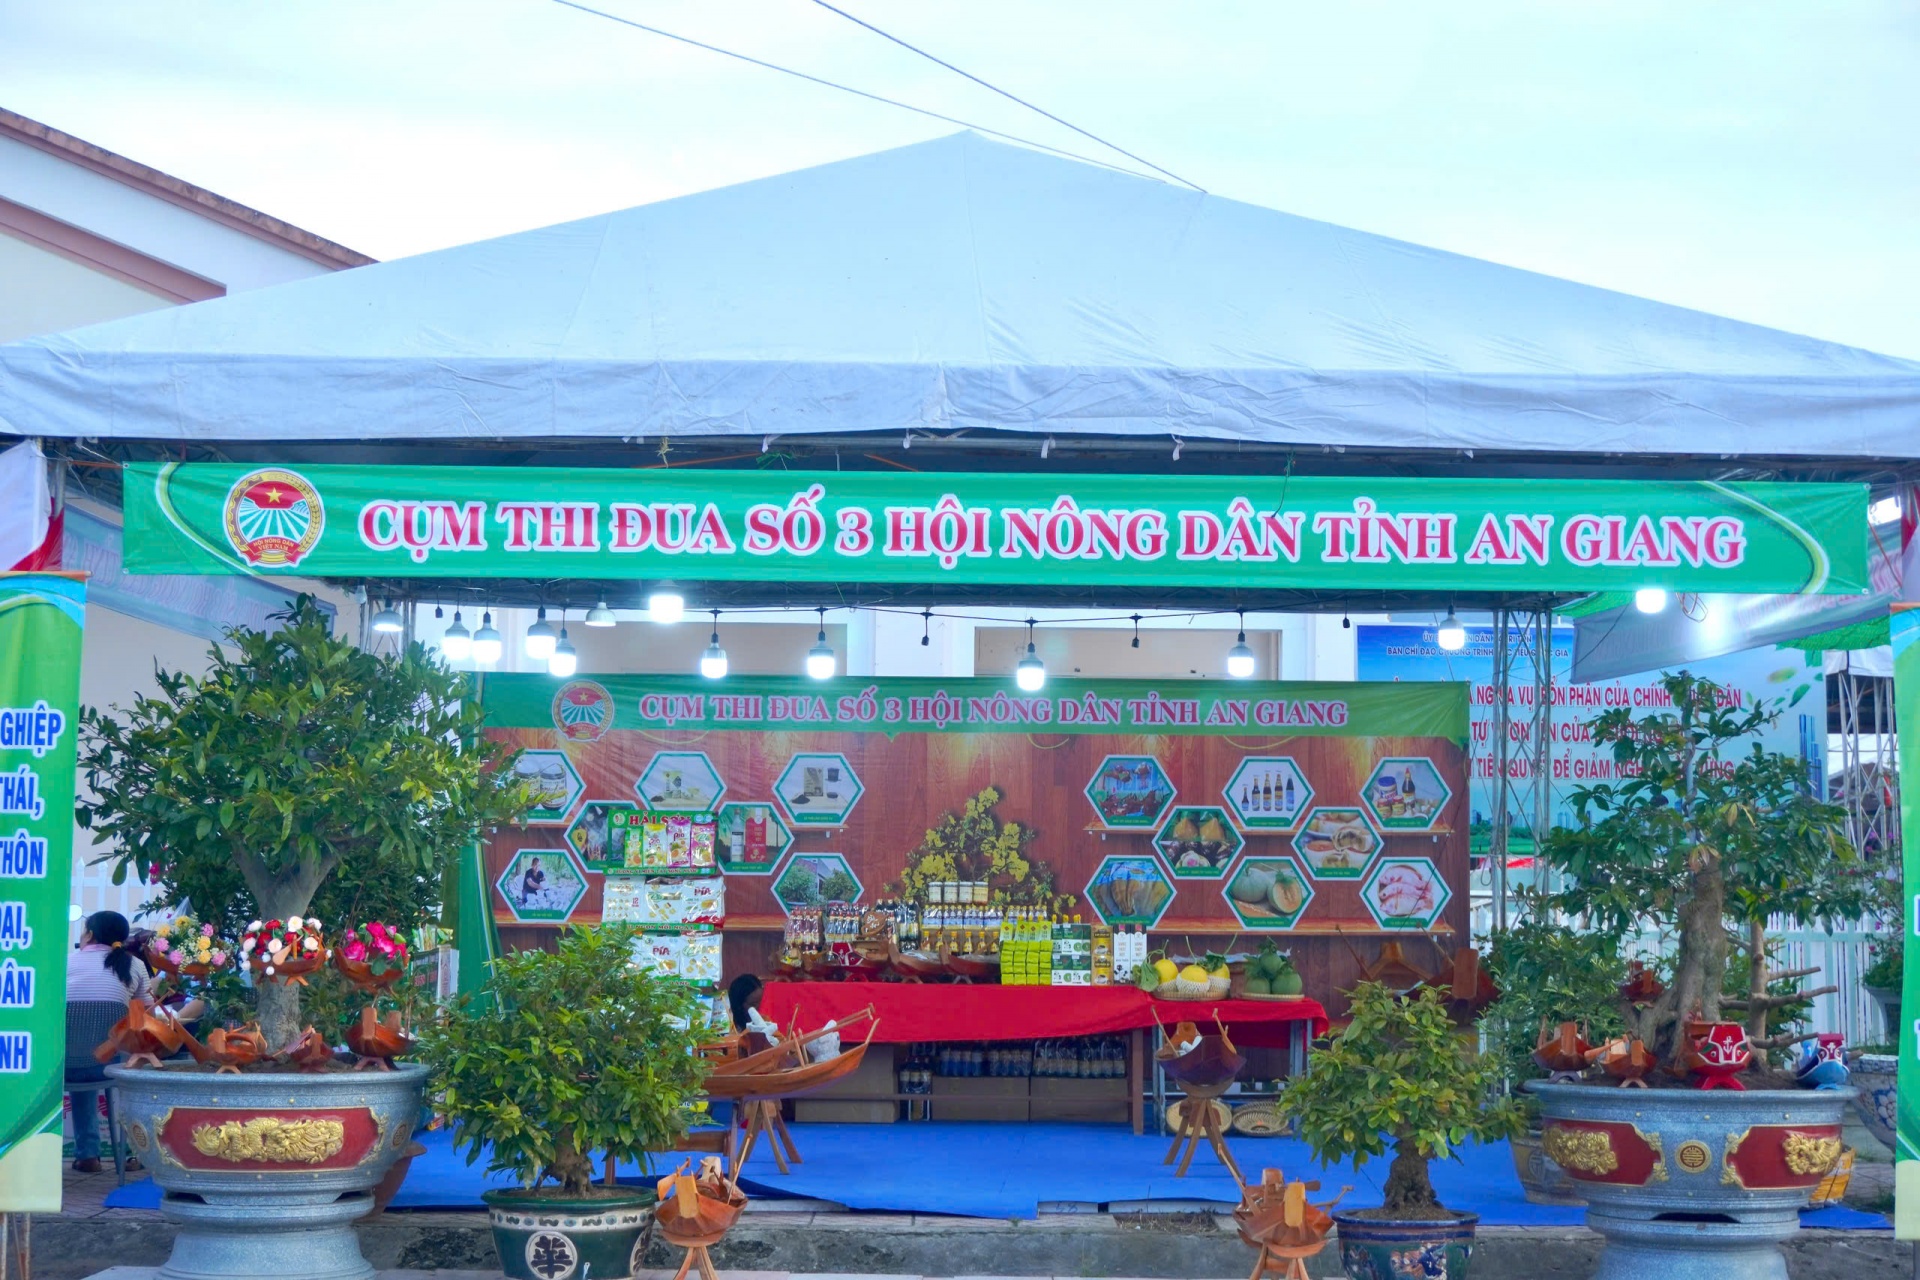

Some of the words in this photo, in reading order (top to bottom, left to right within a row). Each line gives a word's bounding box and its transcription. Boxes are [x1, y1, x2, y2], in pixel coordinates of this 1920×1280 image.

[362, 504, 483, 559] CỤM
[500, 506, 598, 548] THI
[614, 507, 734, 550] ĐUA
[747, 488, 822, 551] SỐ
[839, 511, 870, 552] 3
[888, 498, 988, 565] HỘI
[1005, 499, 1164, 556] NÔNG
[1181, 501, 1302, 558] DÂN
[1317, 496, 1460, 560] TỈNH
[1470, 518, 1551, 561] AN
[1564, 518, 1743, 563] GIANG
[1387, 646, 1403, 656] BAN
[641, 696, 702, 724] CỤM
[711, 697, 762, 720] THI
[770, 698, 831, 721] ĐUA
[838, 685, 877, 721] SỐ
[884, 699, 901, 721] 3
[909, 690, 962, 728] HỘI
[969, 691, 1051, 723] NÔNG
[1059, 692, 1121, 723] DÂN
[1129, 692, 1199, 724] TỈNH
[1208, 702, 1249, 725] AN
[1255, 701, 1348, 726] GIANG
[1569, 681, 1601, 712] PHẬN
[1604, 680, 1630, 707] CỦA
[1716, 683, 1742, 708] DÂN
[1561, 716, 1591, 743] CỦA
[1553, 748, 1570, 778] ĐỂ
[1574, 751, 1611, 779] GIẢM
[0, 767, 42, 817] HÁI,
[629, 811, 658, 826] HẢI
[0, 831, 45, 876] HÔN
[0, 904, 29, 947] ẠI,
[0, 961, 32, 1005] ÂN
